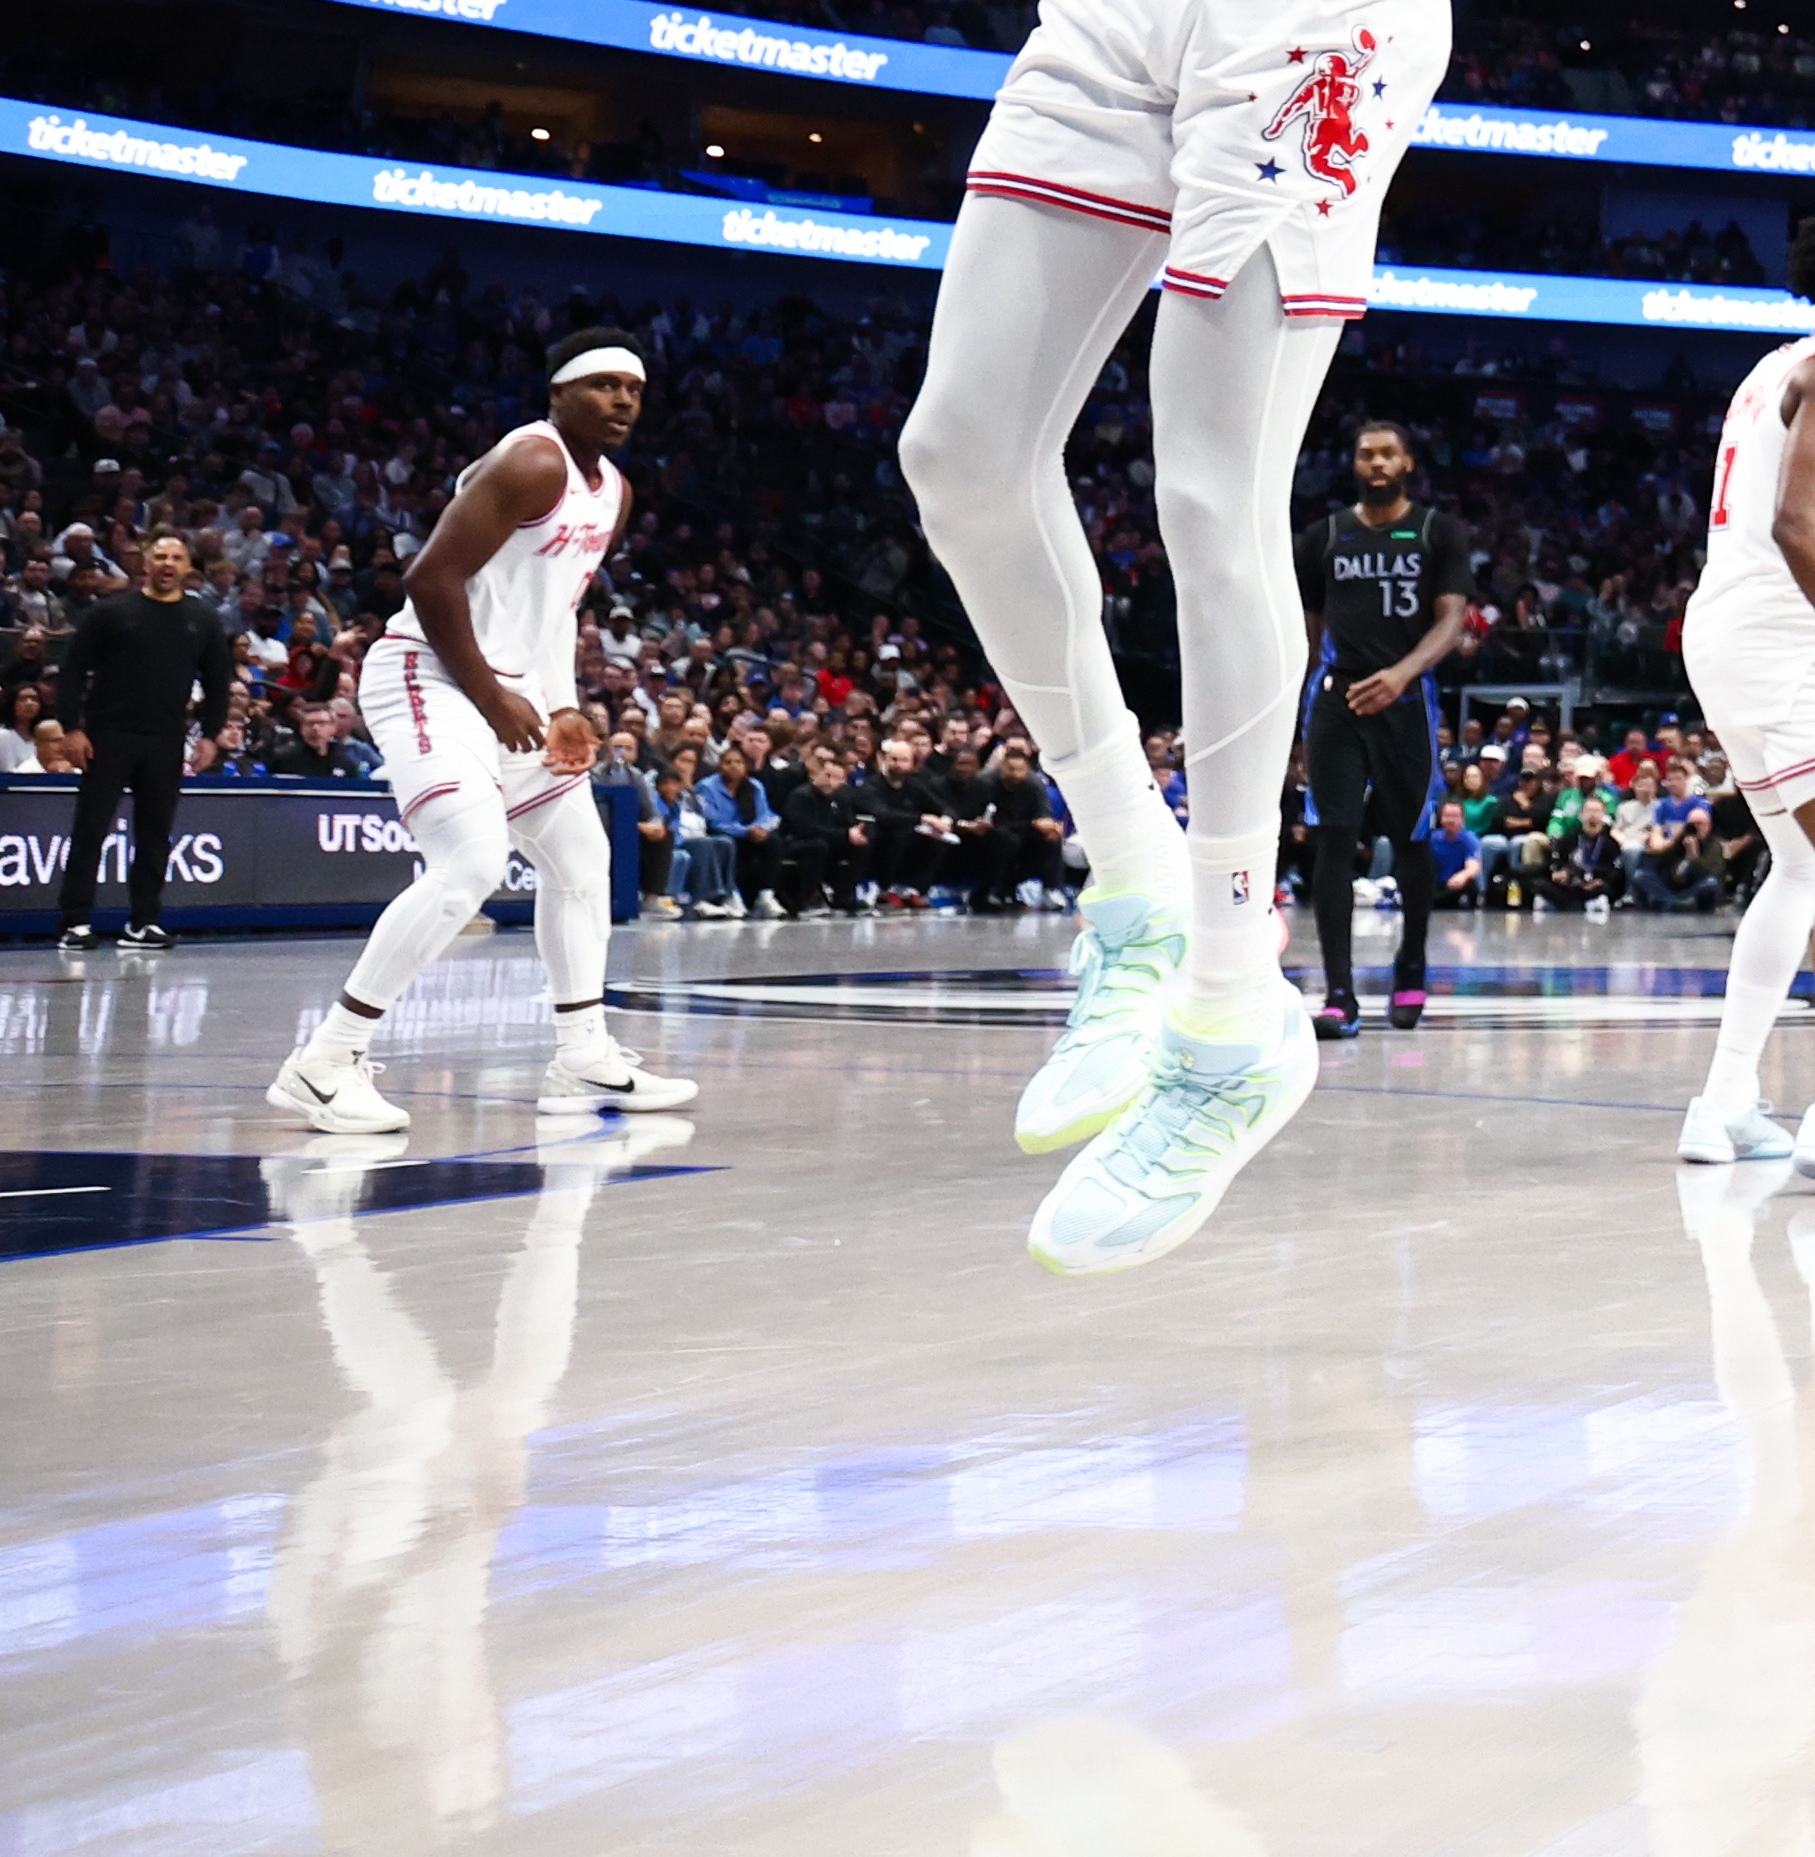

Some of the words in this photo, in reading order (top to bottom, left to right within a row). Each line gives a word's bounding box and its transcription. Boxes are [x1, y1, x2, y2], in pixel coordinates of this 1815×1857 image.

[650, 12, 888, 80] ticketmaster
[28, 115, 248, 181] ticketmaster
[1414, 107, 1607, 157] cketmaster
[373, 168, 603, 225] ticketmaster
[722, 208, 931, 261] ticketmaster
[1367, 271, 1538, 313] cketmaster
[1334, 553, 1422, 581] DALLAS
[1379, 580, 1420, 618] 13
